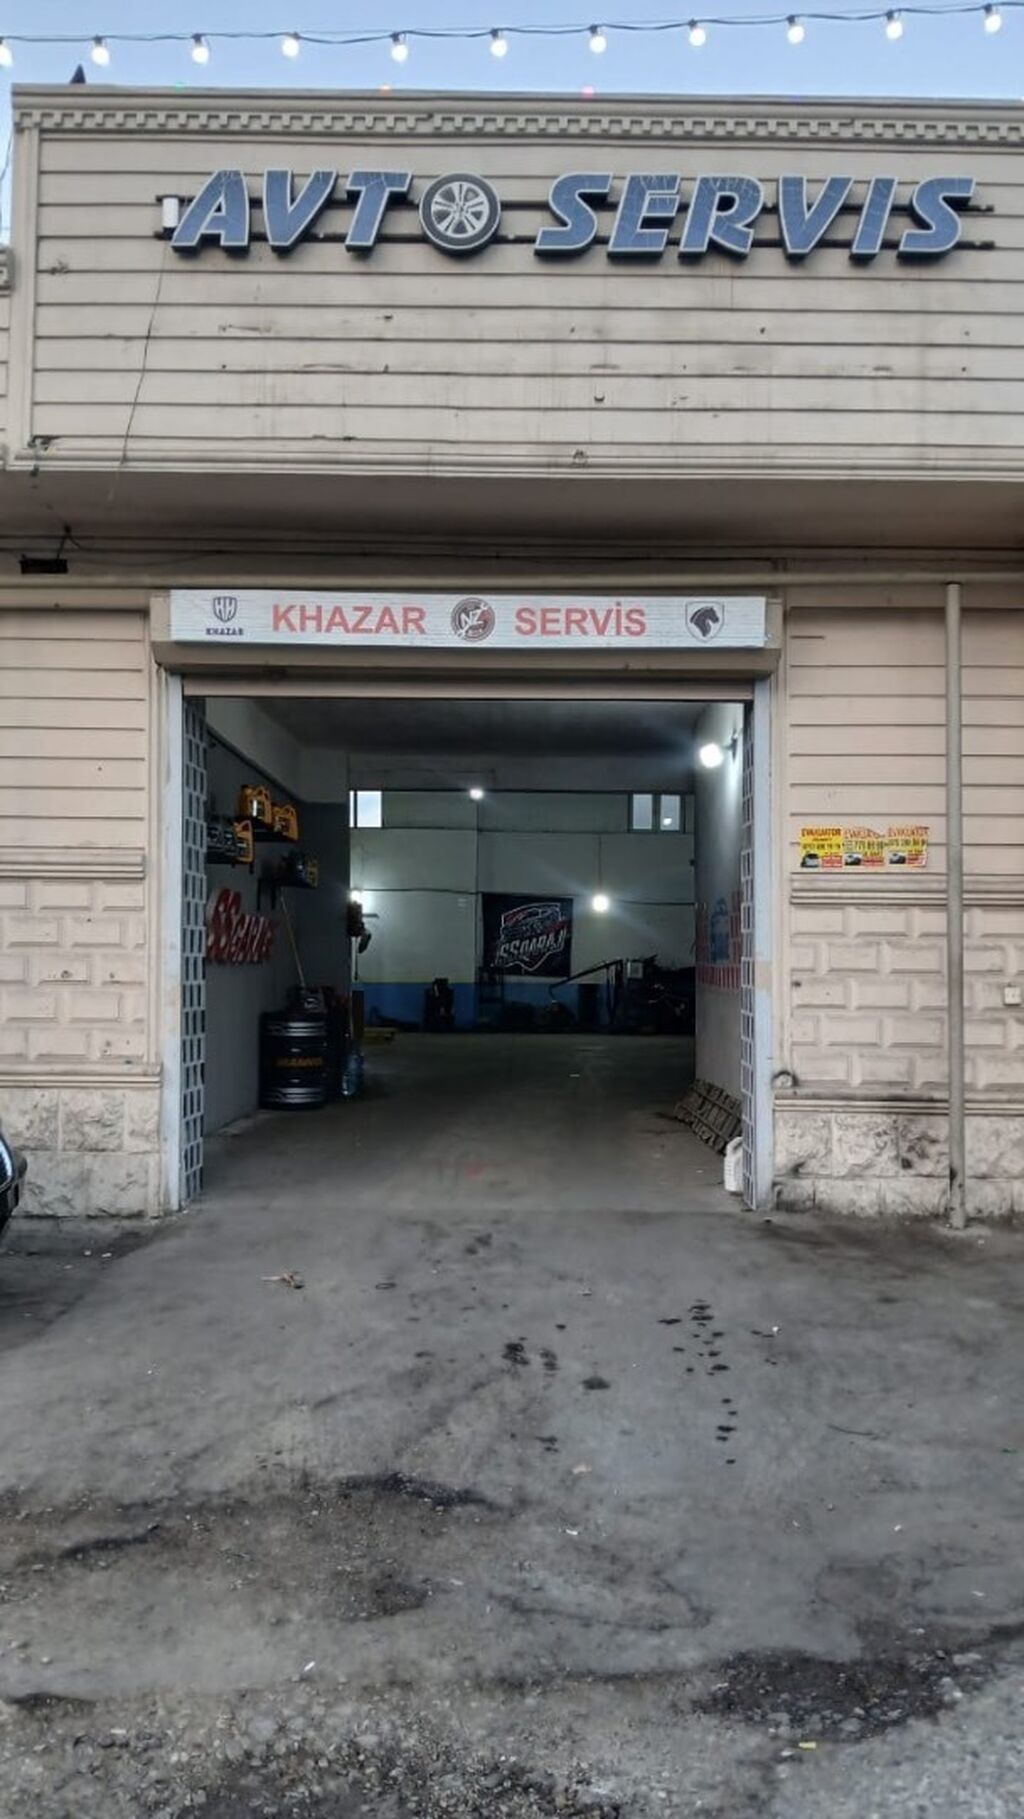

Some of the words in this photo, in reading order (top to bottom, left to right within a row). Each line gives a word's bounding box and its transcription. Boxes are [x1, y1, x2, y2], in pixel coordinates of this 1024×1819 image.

[535, 172, 976, 256] SERVIS
[273, 604, 426, 634] KHAZAR
[514, 602, 645, 637] SERVİS
